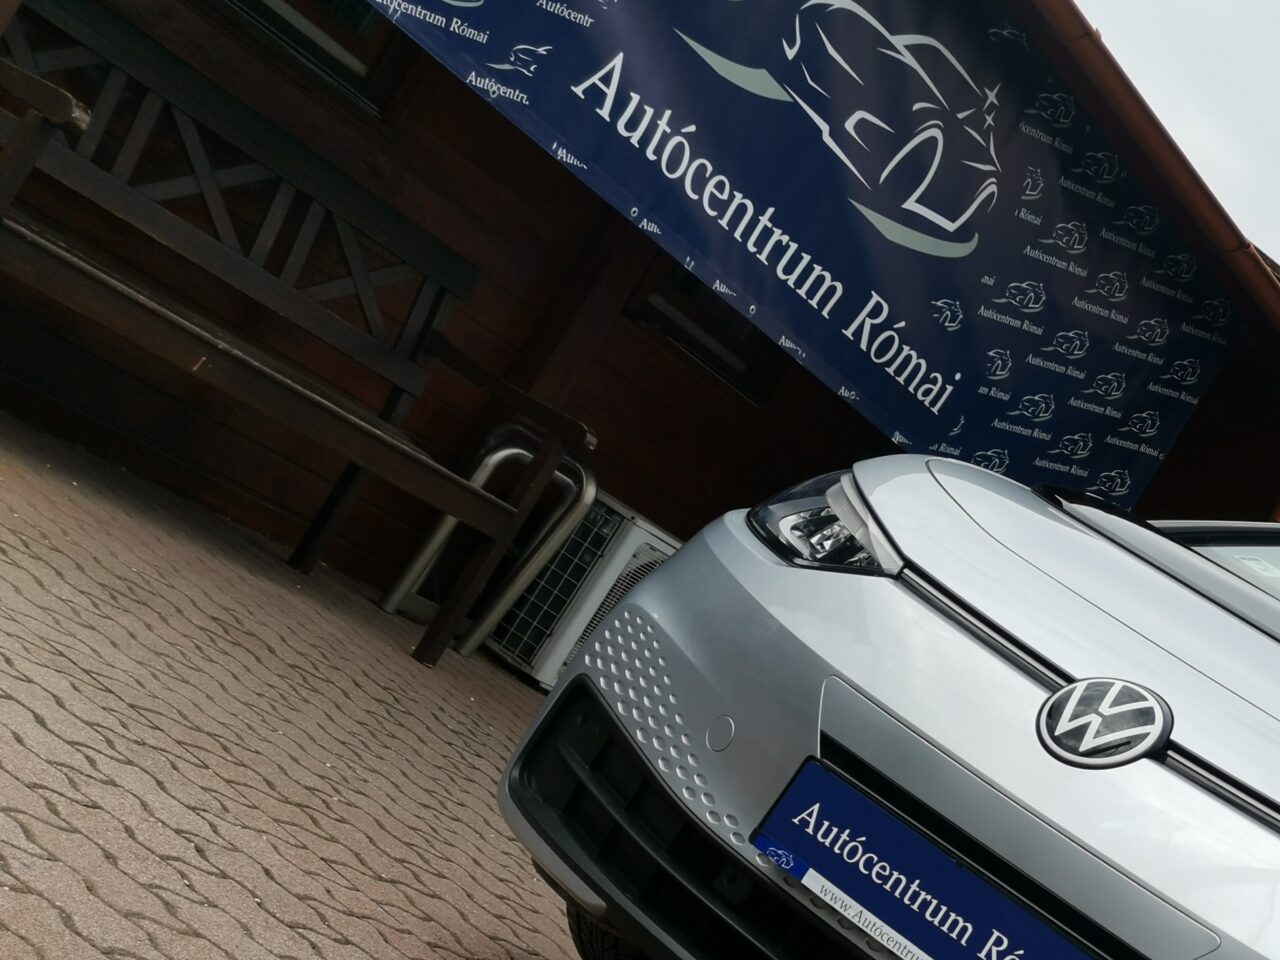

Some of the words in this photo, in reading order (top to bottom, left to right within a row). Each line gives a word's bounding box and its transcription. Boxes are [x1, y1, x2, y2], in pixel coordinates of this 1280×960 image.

[449, 17, 490, 44] Római
[570, 51, 844, 319] Autócentrum
[841, 291, 962, 416] Római
[791, 802, 974, 946] Autócentrum
